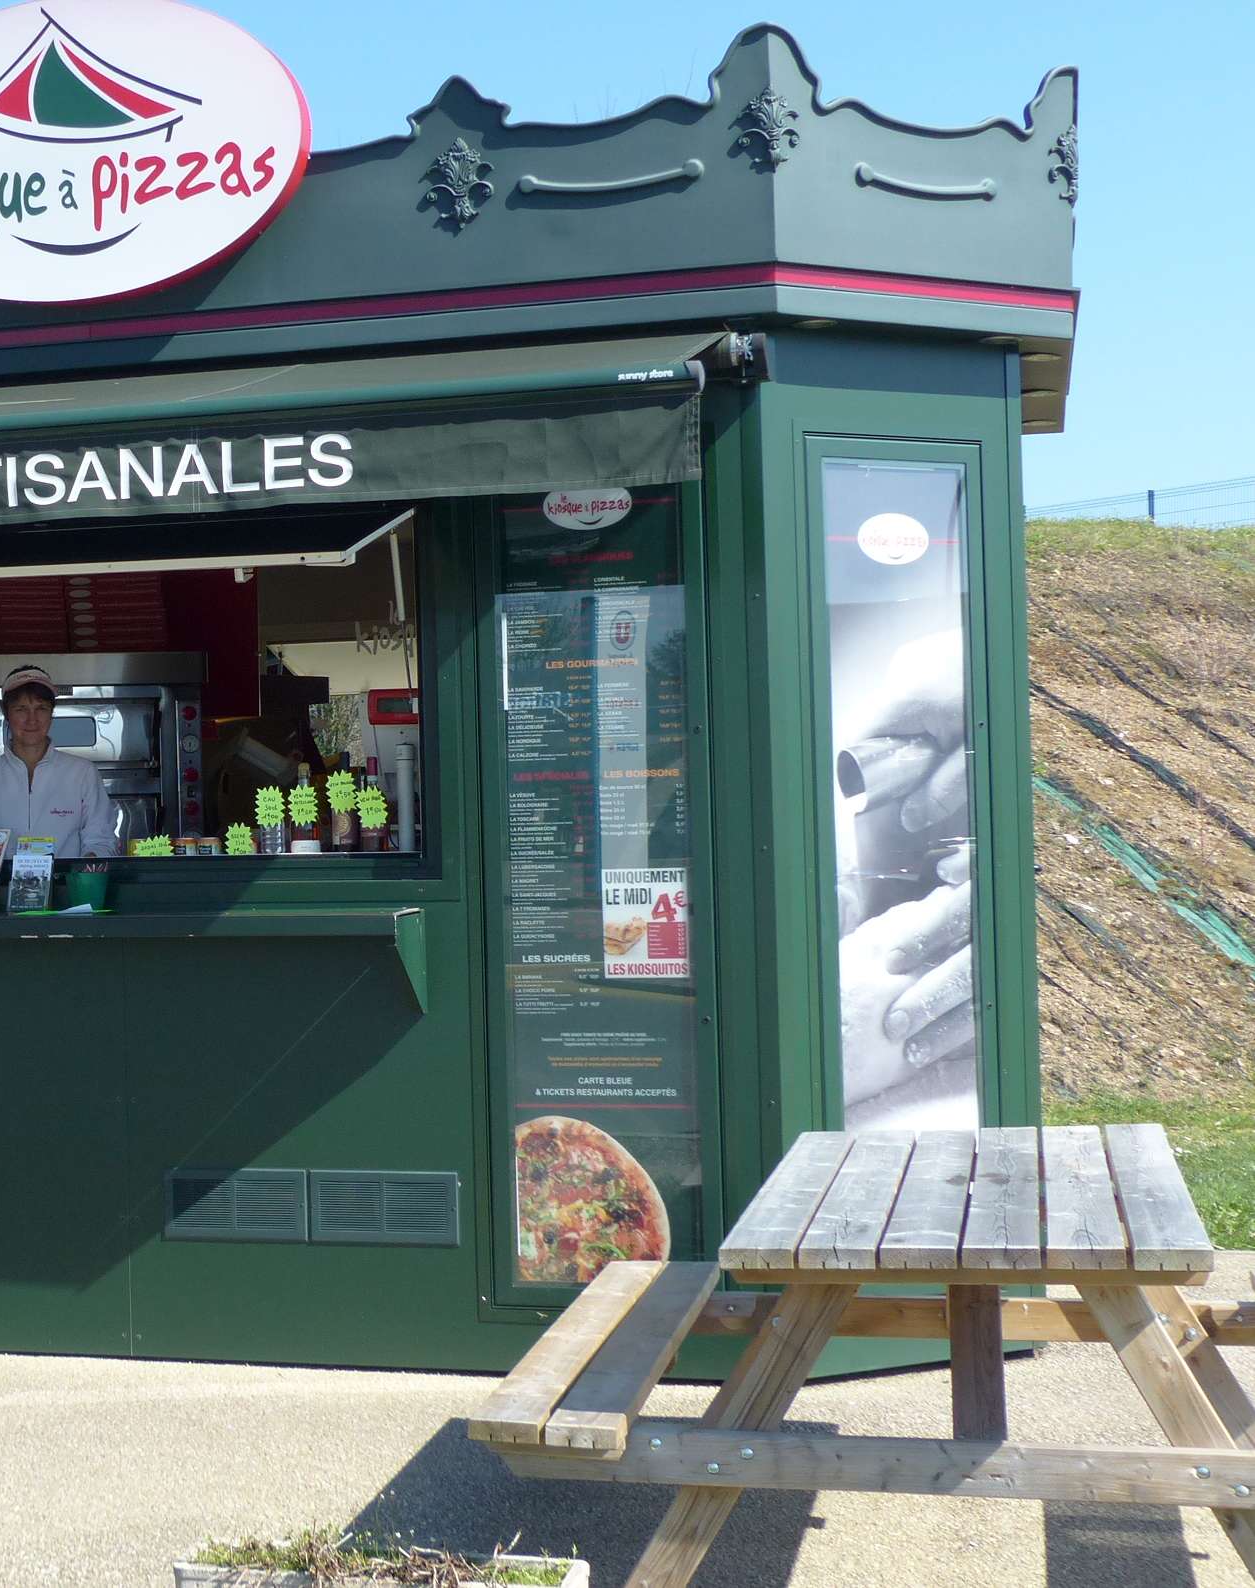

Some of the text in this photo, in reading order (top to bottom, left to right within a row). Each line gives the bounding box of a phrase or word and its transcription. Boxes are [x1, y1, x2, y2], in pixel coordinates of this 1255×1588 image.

[58, 170, 78, 210] à
[92, 141, 276, 232] pizzas
[547, 502, 583, 516] kiosque
[591, 499, 630, 516] pizzas
[546, 661, 564, 669] LES
[603, 768, 681, 778] LES BOISSONS
[605, 870, 684, 884] UNIQUEMENT
[606, 887, 652, 905] LE MIDI
[522, 952, 591, 963] LES SUCRÉES
[607, 962, 689, 977] LES KIOSQUITOS
[578, 1077, 632, 1085] CARTE BLEUE
[542, 1088, 575, 1096] TICKETS
[576, 1088, 633, 1097] RESTAURANTS
[635, 1087, 677, 1097] ACCEPTÉS
